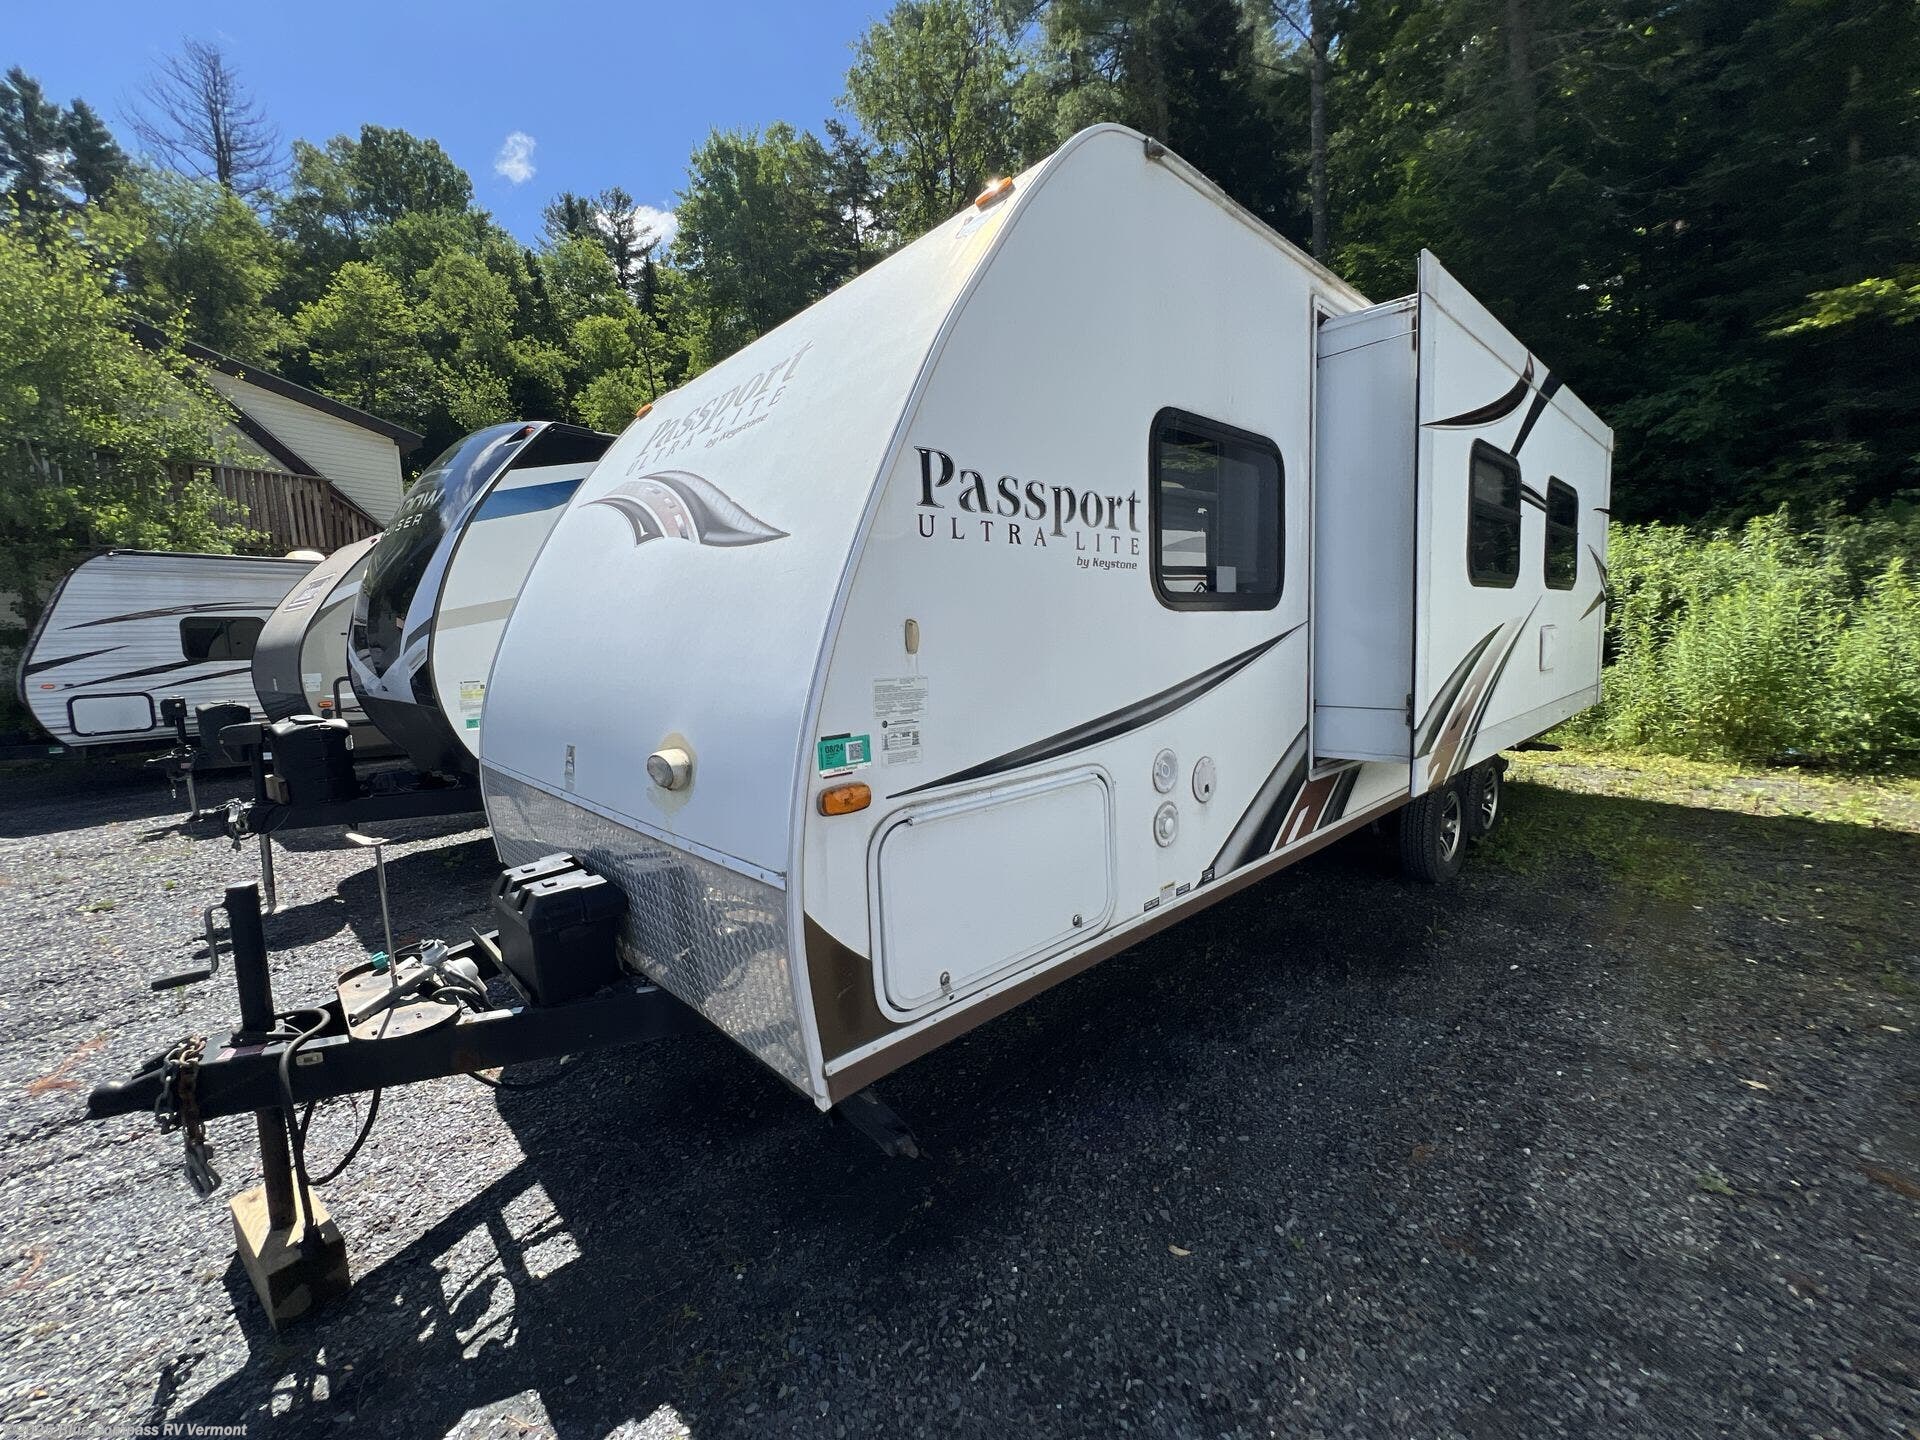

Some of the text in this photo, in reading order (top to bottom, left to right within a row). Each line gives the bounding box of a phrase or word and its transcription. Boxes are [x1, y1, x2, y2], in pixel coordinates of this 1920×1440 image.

[625, 385, 786, 477] ULTRA LITE
[914, 445, 1141, 537] Passport
[918, 513, 1140, 556] ULTRA LITE
[1076, 556, 1138, 571] by Keystone
[824, 743, 844, 754] 08/24
